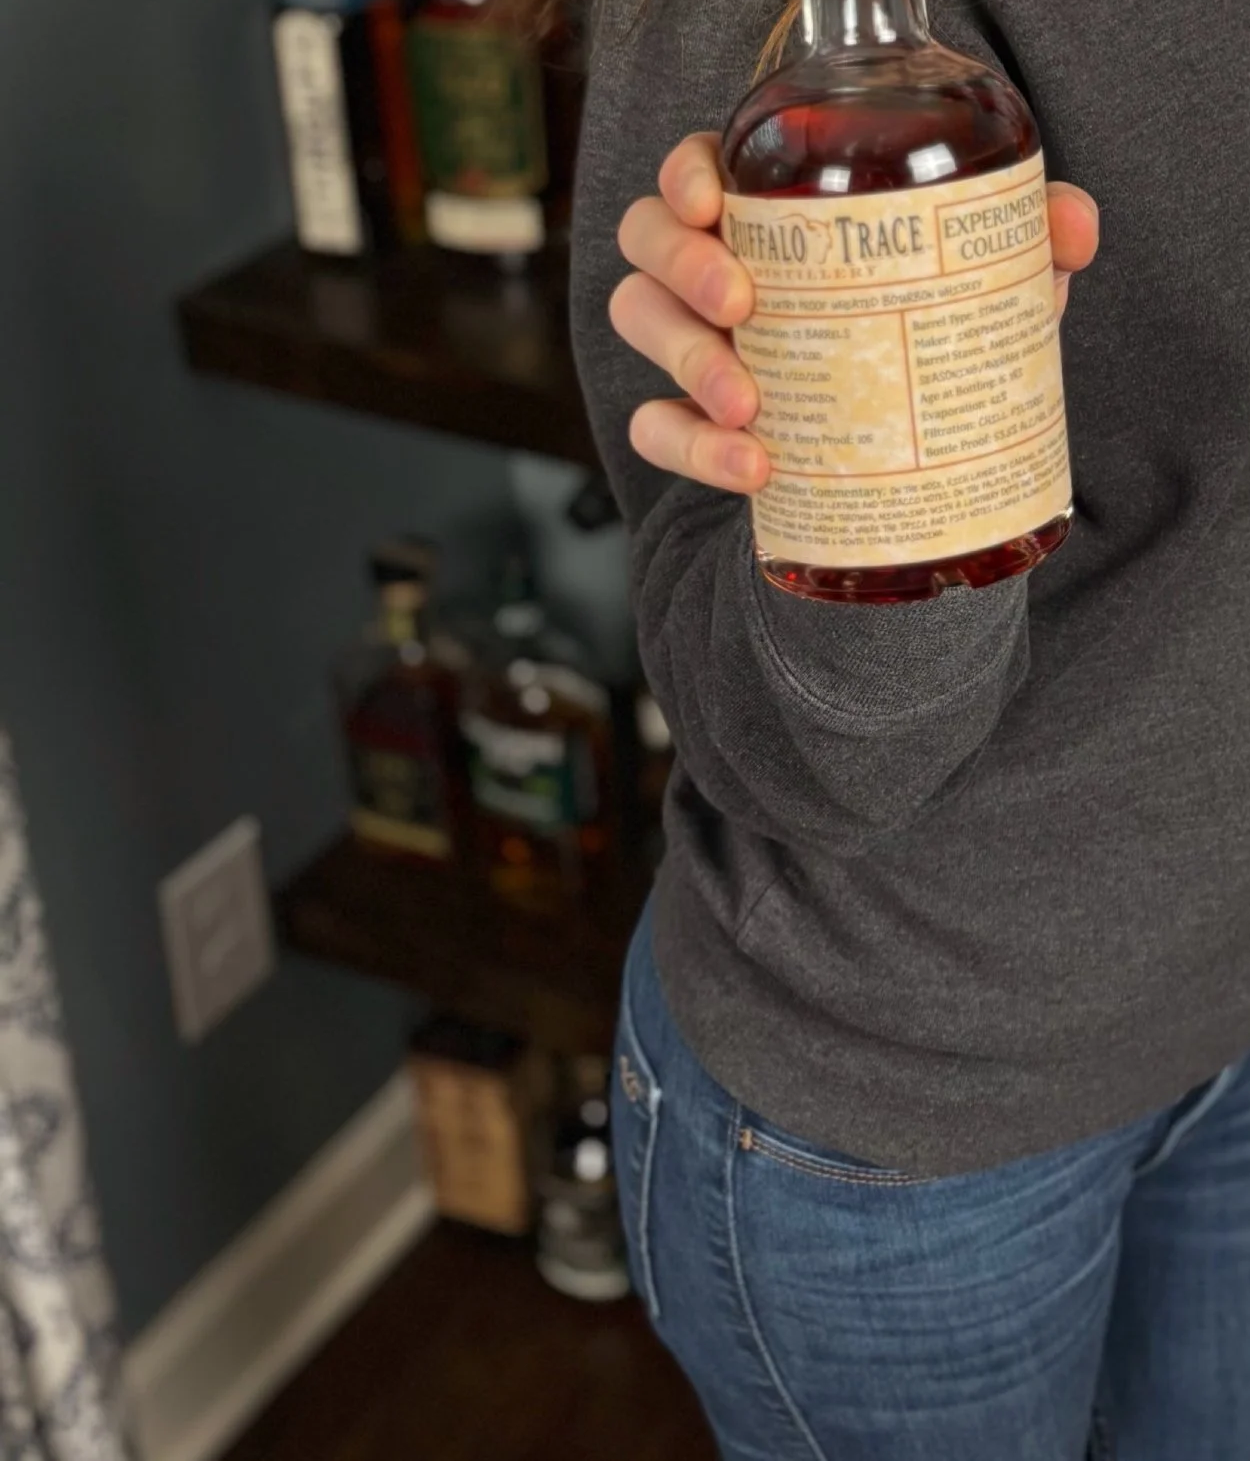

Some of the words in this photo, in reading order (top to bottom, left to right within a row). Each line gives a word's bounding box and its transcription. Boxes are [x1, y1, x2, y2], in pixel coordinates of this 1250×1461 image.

[943, 189, 1044, 239] EXPERIMENTA
[728, 212, 807, 264] BUFFALO
[834, 214, 924, 264] TRACE
[960, 213, 1046, 261] COLLECTION
[753, 266, 877, 281] DISTILLERY
[882, 289, 936, 307] BOURBON
[913, 315, 947, 332] Barrel
[949, 313, 976, 326] Type:
[914, 335, 951, 350] Maker:
[916, 351, 950, 368] Barrel
[920, 392, 940, 407] Age
[921, 400, 989, 423] Evaporation:
[923, 421, 977, 440] Filtration:
[795, 433, 820, 447] Entry
[821, 433, 854, 445] Proof:
[925, 443, 959, 458] Bottle
[960, 433, 993, 451] Proof:
[810, 485, 886, 500] Commentary:
